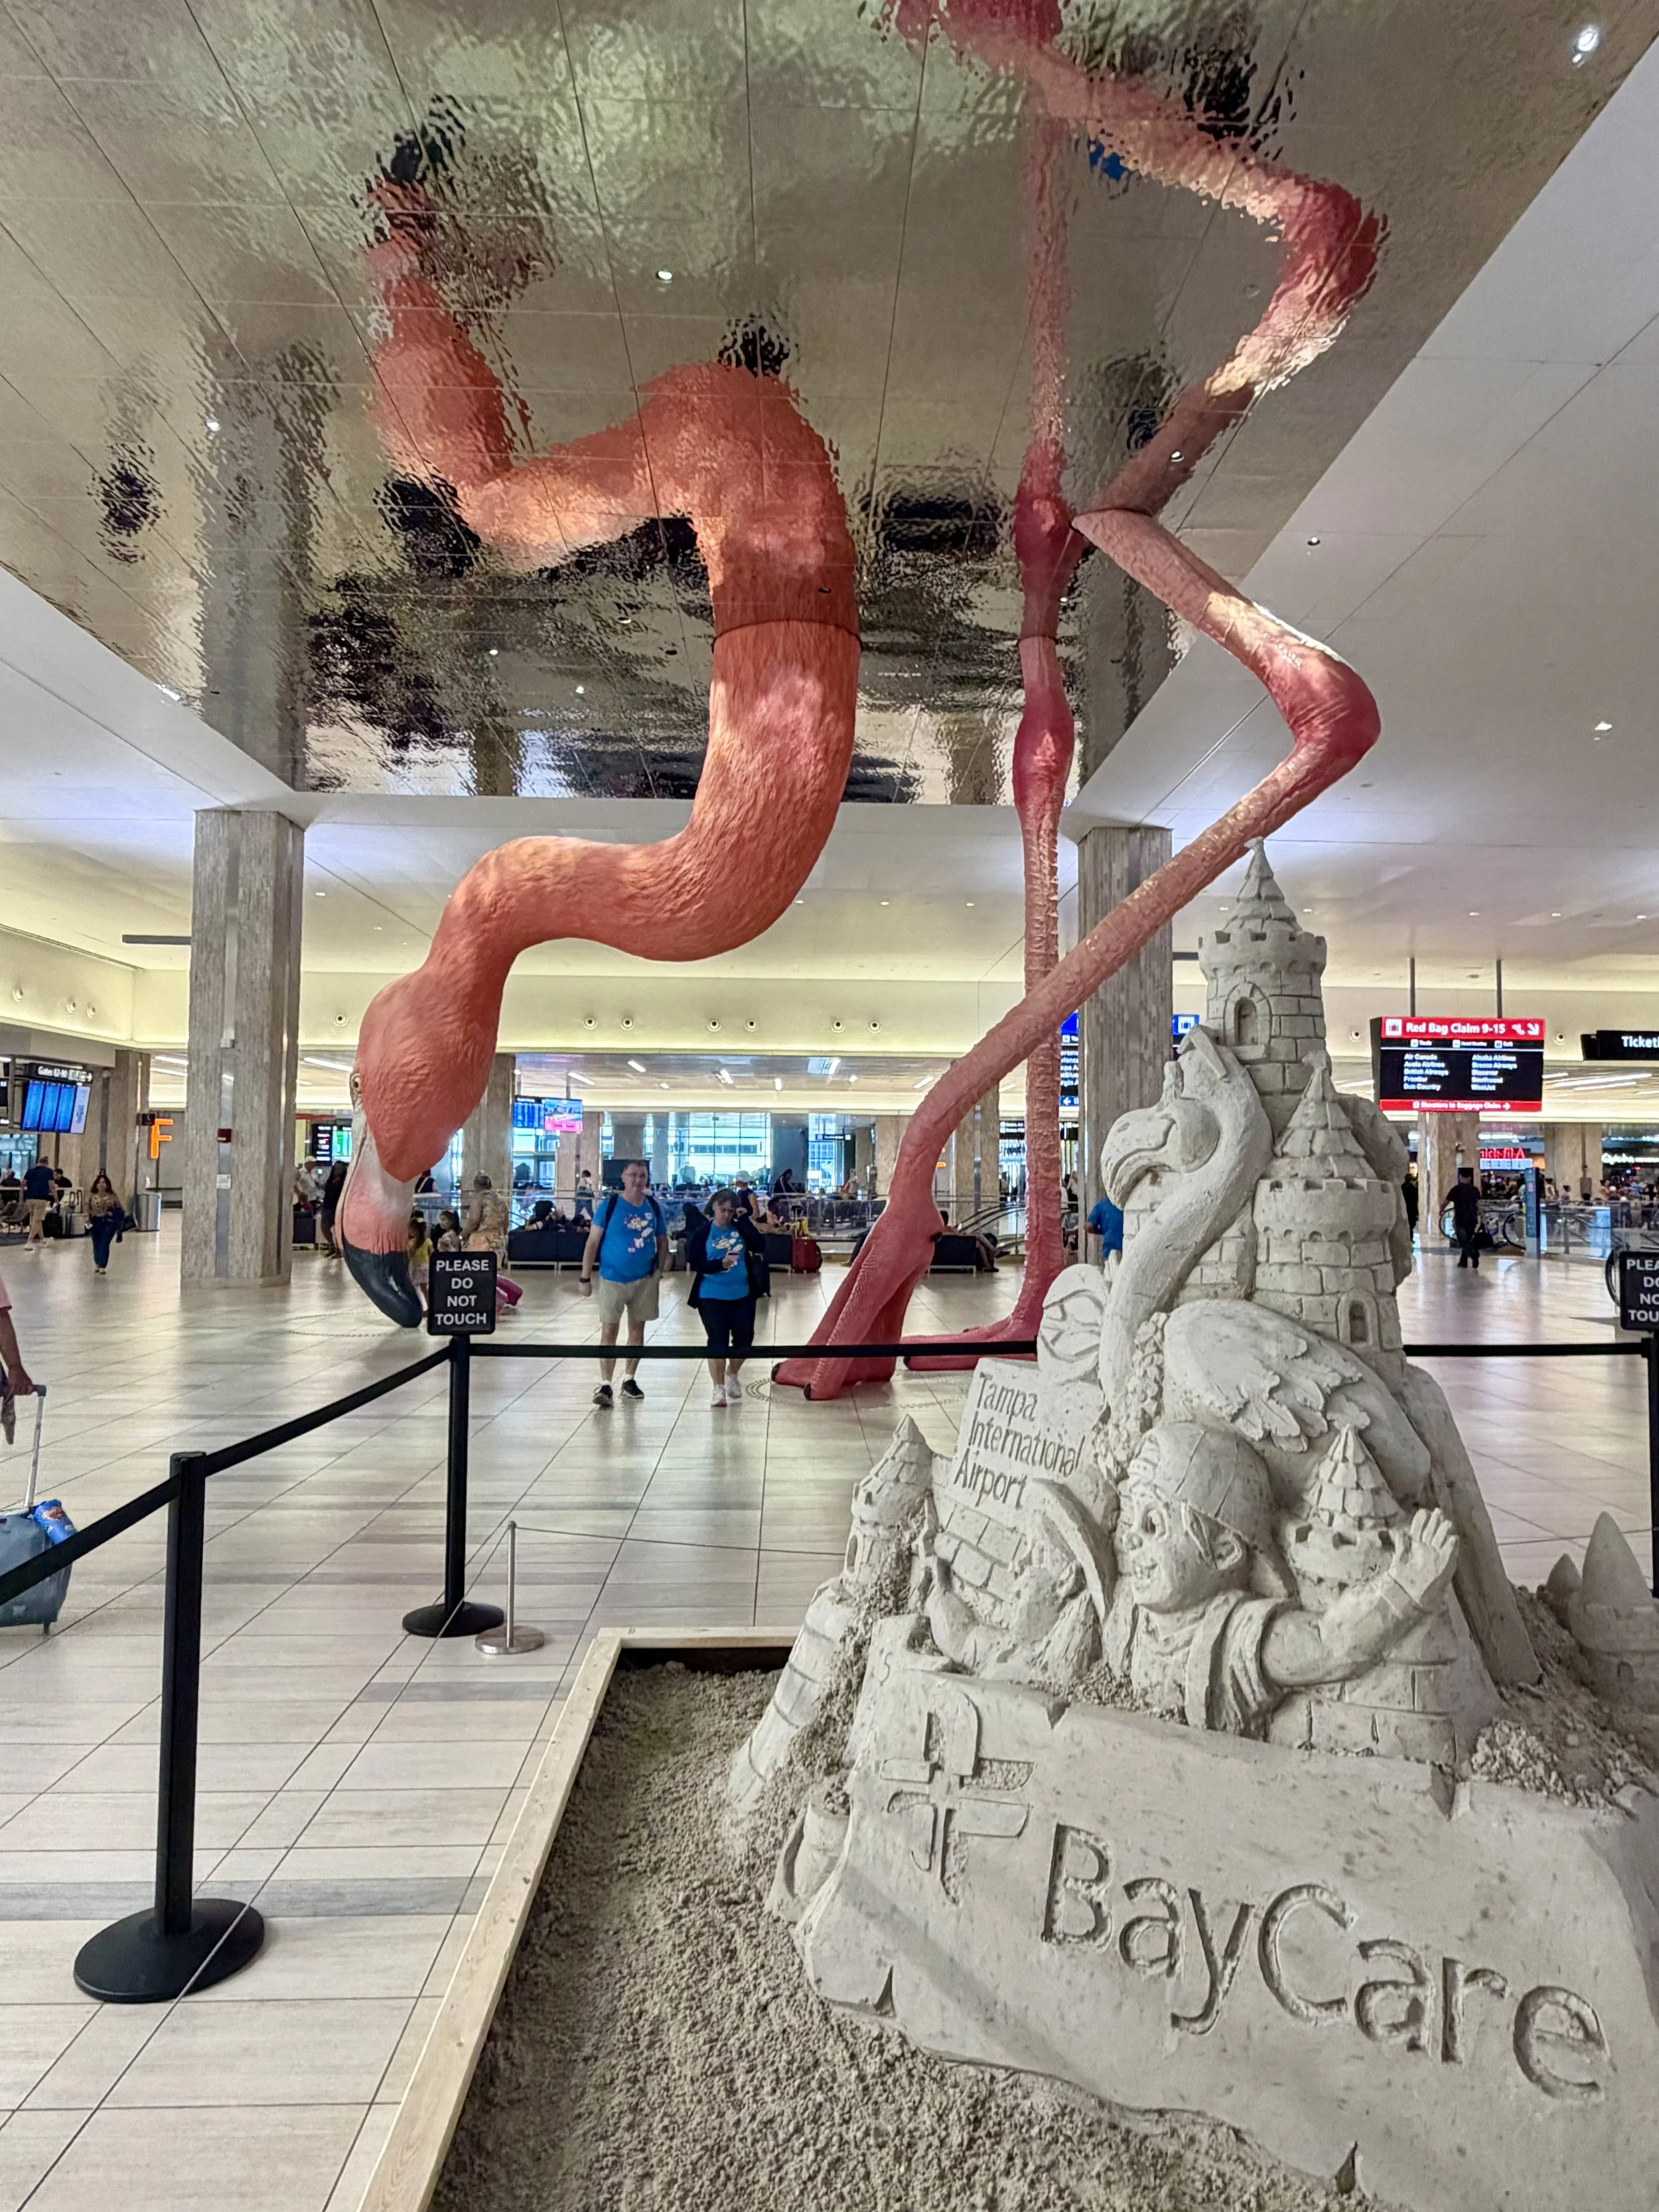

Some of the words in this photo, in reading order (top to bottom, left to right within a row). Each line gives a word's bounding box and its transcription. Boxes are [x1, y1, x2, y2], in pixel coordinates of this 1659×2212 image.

[1406, 1023, 1426, 1033] Red
[1429, 1023, 1448, 1035] Bag
[1451, 1023, 1480, 1033] Claim
[1482, 1023, 1506, 1034] 9-15
[38, 1066, 53, 1076] Gates
[150, 1118, 174, 1159] F
[436, 1260, 489, 1272] PLEASE
[451, 1277, 473, 1289] DO
[447, 1295, 477, 1307] NOT
[435, 1312, 487, 1325] TOUCH
[977, 1372, 1038, 1426] Tampa
[968, 1411, 1086, 1477] International
[954, 1448, 1027, 1509] Airport
[1042, 1822, 1615, 2101] BayCare
